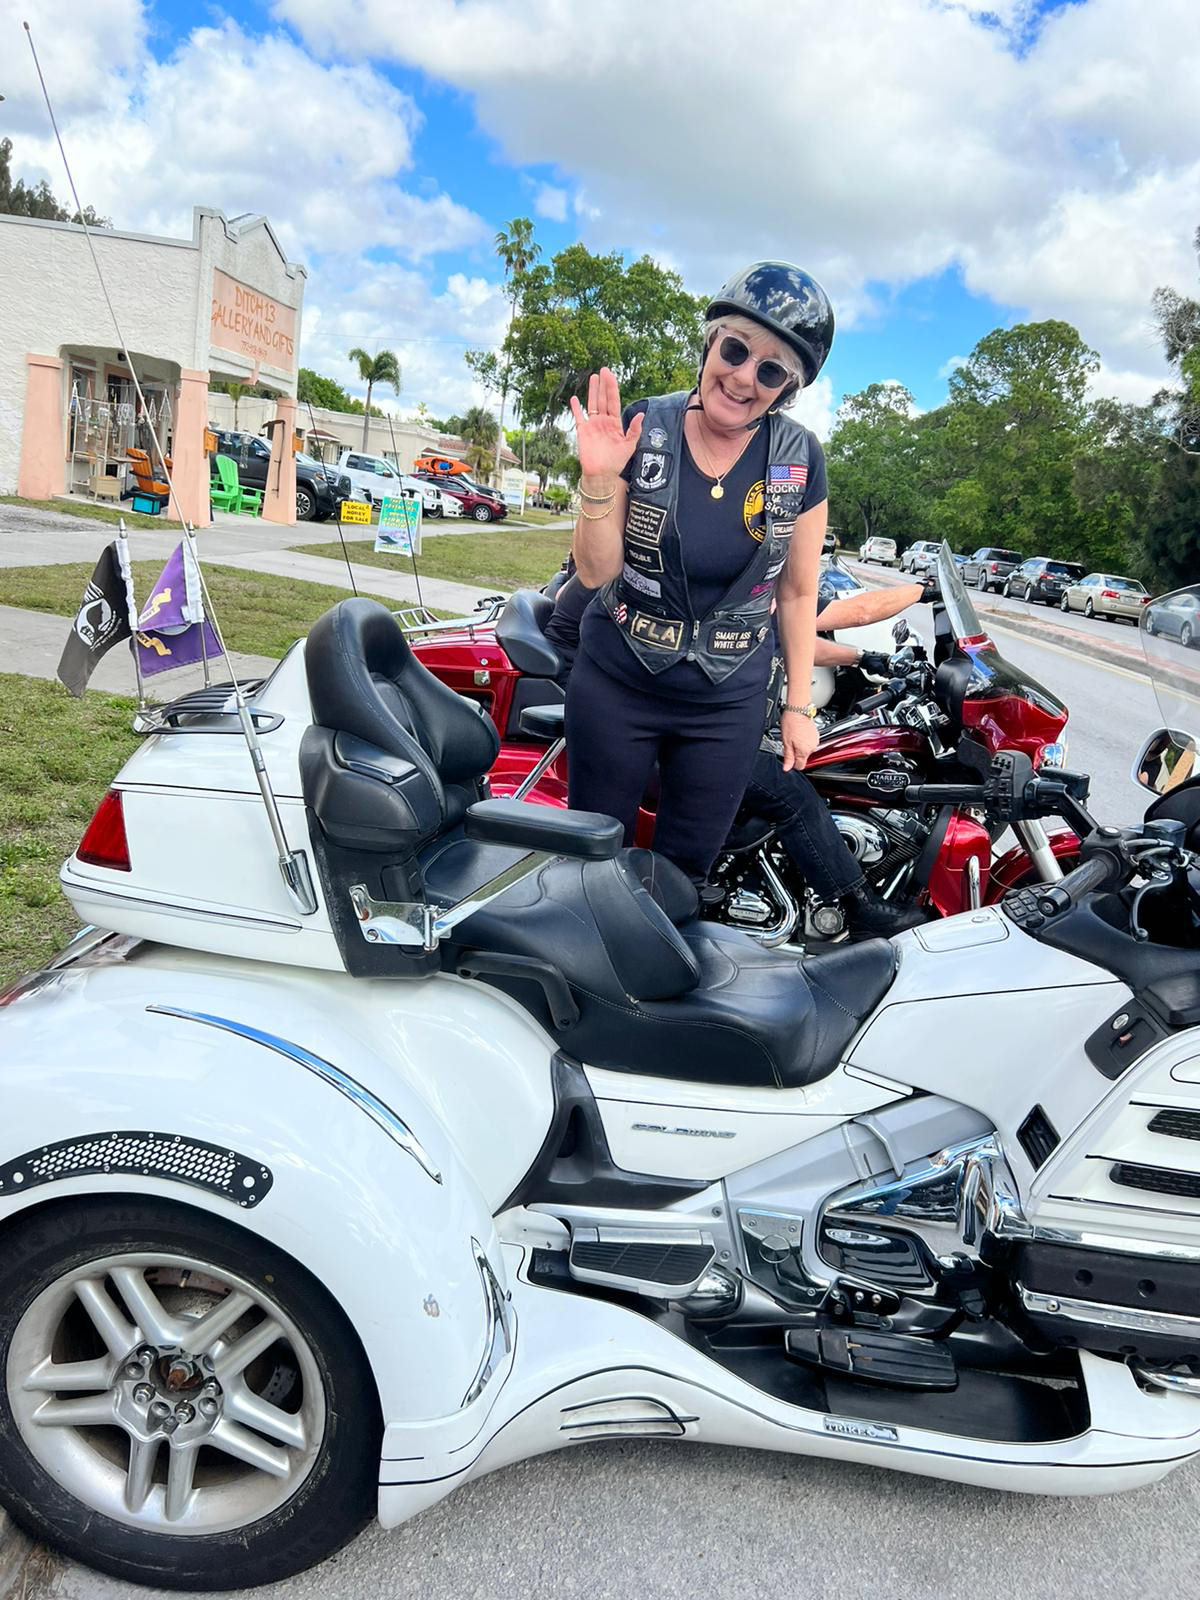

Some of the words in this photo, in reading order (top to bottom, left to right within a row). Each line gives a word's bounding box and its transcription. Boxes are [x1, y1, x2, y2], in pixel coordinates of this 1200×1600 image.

[235, 286, 264, 317] DITCH
[265, 303, 276, 323] 13
[211, 299, 254, 338] GALLERY
[253, 322, 272, 346] AND
[766, 484, 801, 494] ROCKY
[635, 619, 676, 643] FLA
[715, 631, 739, 641] SMART
[739, 631, 752, 640] ASS
[713, 640, 735, 649] WHITE
[735, 640, 749, 649] GIRL
